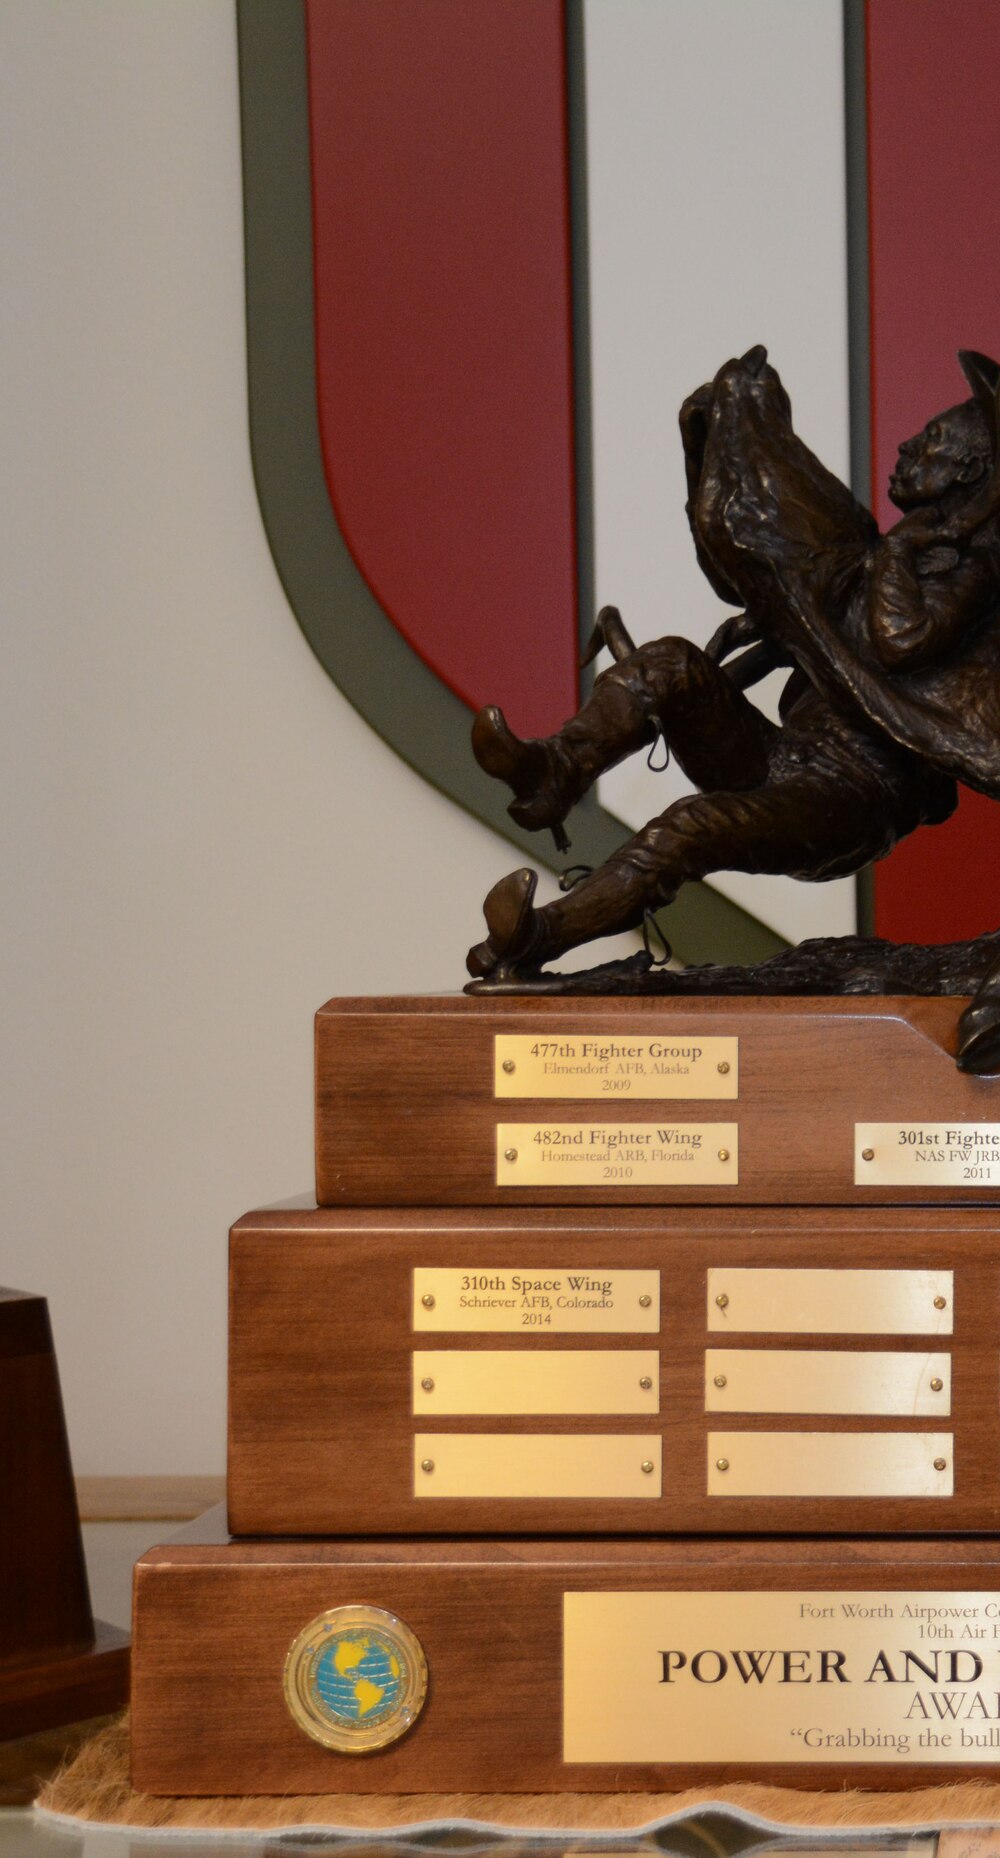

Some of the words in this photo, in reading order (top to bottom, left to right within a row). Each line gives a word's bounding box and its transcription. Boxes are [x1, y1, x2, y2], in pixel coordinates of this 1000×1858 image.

[530, 1043, 576, 1058] 477th
[581, 1043, 643, 1062] Fighter
[648, 1043, 702, 1062] Group
[544, 1063, 610, 1074] Elmendorf
[616, 1063, 646, 1076] AFB,
[650, 1063, 690, 1074] Alaska
[602, 1080, 631, 1091] 2009
[533, 1130, 583, 1145] 482nd
[589, 1130, 652, 1150] Fighter
[656, 1130, 703, 1150] Wing
[898, 1130, 940, 1145] 301st
[541, 1150, 610, 1161] Homestead
[615, 1150, 647, 1163] ARB,
[652, 1150, 695, 1161] Florida
[915, 1150, 945, 1162] NAS
[949, 1150, 974, 1162] FW
[603, 1167, 633, 1178] 2010
[963, 1167, 990, 1178] 2011
[462, 1276, 505, 1291] 310th
[511, 1276, 562, 1296] Space
[566, 1276, 613, 1296] Wing
[459, 1296, 517, 1309] Schriever
[520, 1296, 553, 1311] AFB,
[556, 1296, 614, 1309] Colorado
[522, 1313, 552, 1325] 2014
[800, 1603, 835, 1618] Fort
[841, 1603, 894, 1618] Worth
[900, 1603, 978, 1622] Airpower
[918, 1623, 954, 1638] 10th
[960, 1623, 986, 1638] Air
[657, 1649, 852, 1685] POWER
[863, 1649, 984, 1685] AND
[918, 1728, 952, 1747] the
